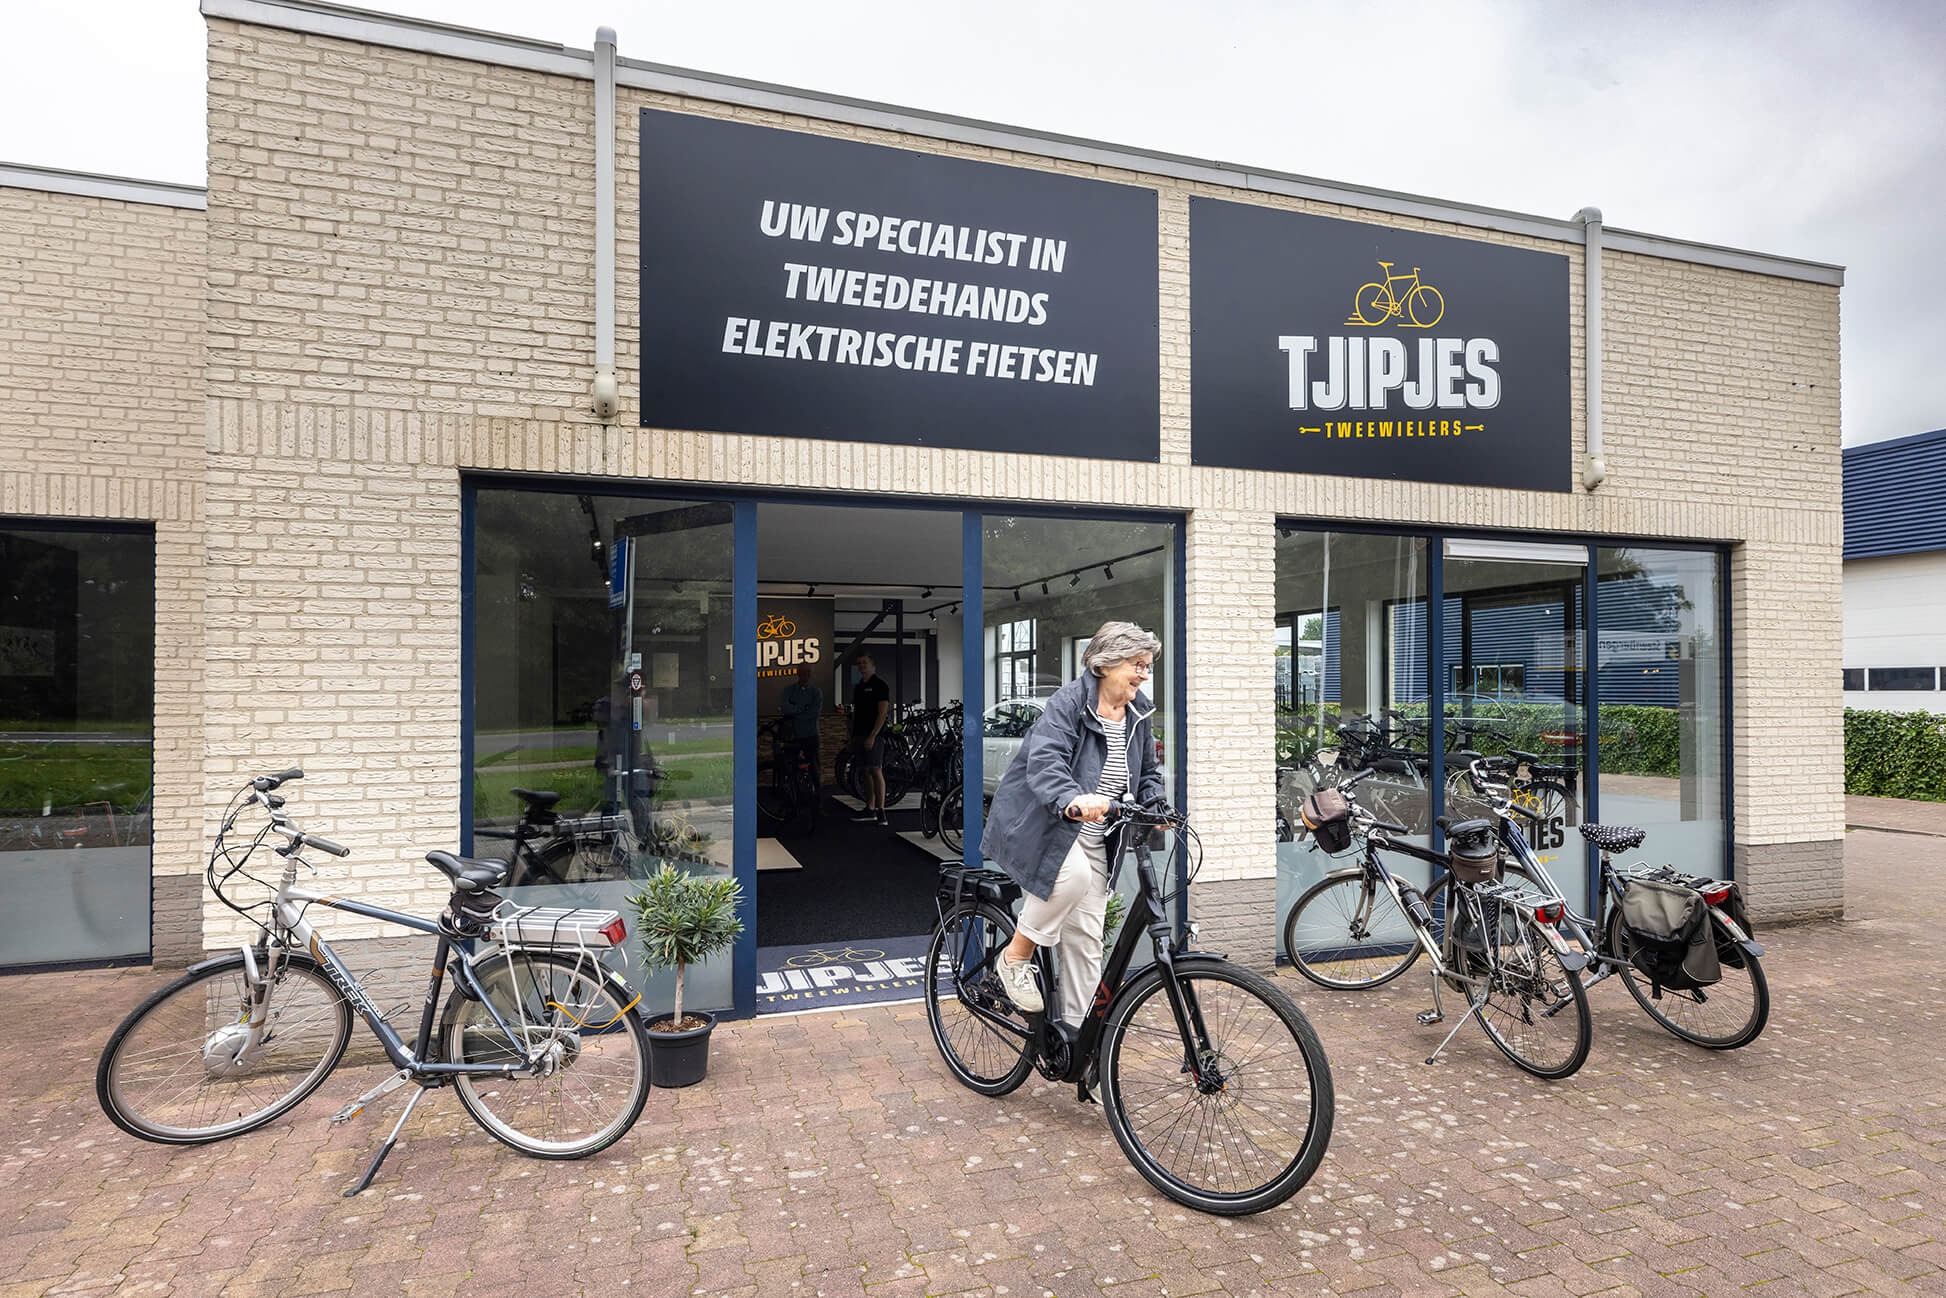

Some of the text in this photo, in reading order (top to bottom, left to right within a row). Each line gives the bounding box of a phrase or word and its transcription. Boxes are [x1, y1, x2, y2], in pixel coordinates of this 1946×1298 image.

[760, 200, 1068, 273] UW SPECIALIST IN
[784, 263, 1050, 326] TWEEDEHANDS
[721, 316, 1099, 387] ELEKTRISCHE FIETSEN
[1278, 335, 1502, 411] TJIPJES
[1324, 420, 1462, 439] TWEEWIELERS
[725, 637, 820, 669] TIPJES
[322, 957, 370, 1016] TREK
[756, 953, 964, 994] JIPJES
